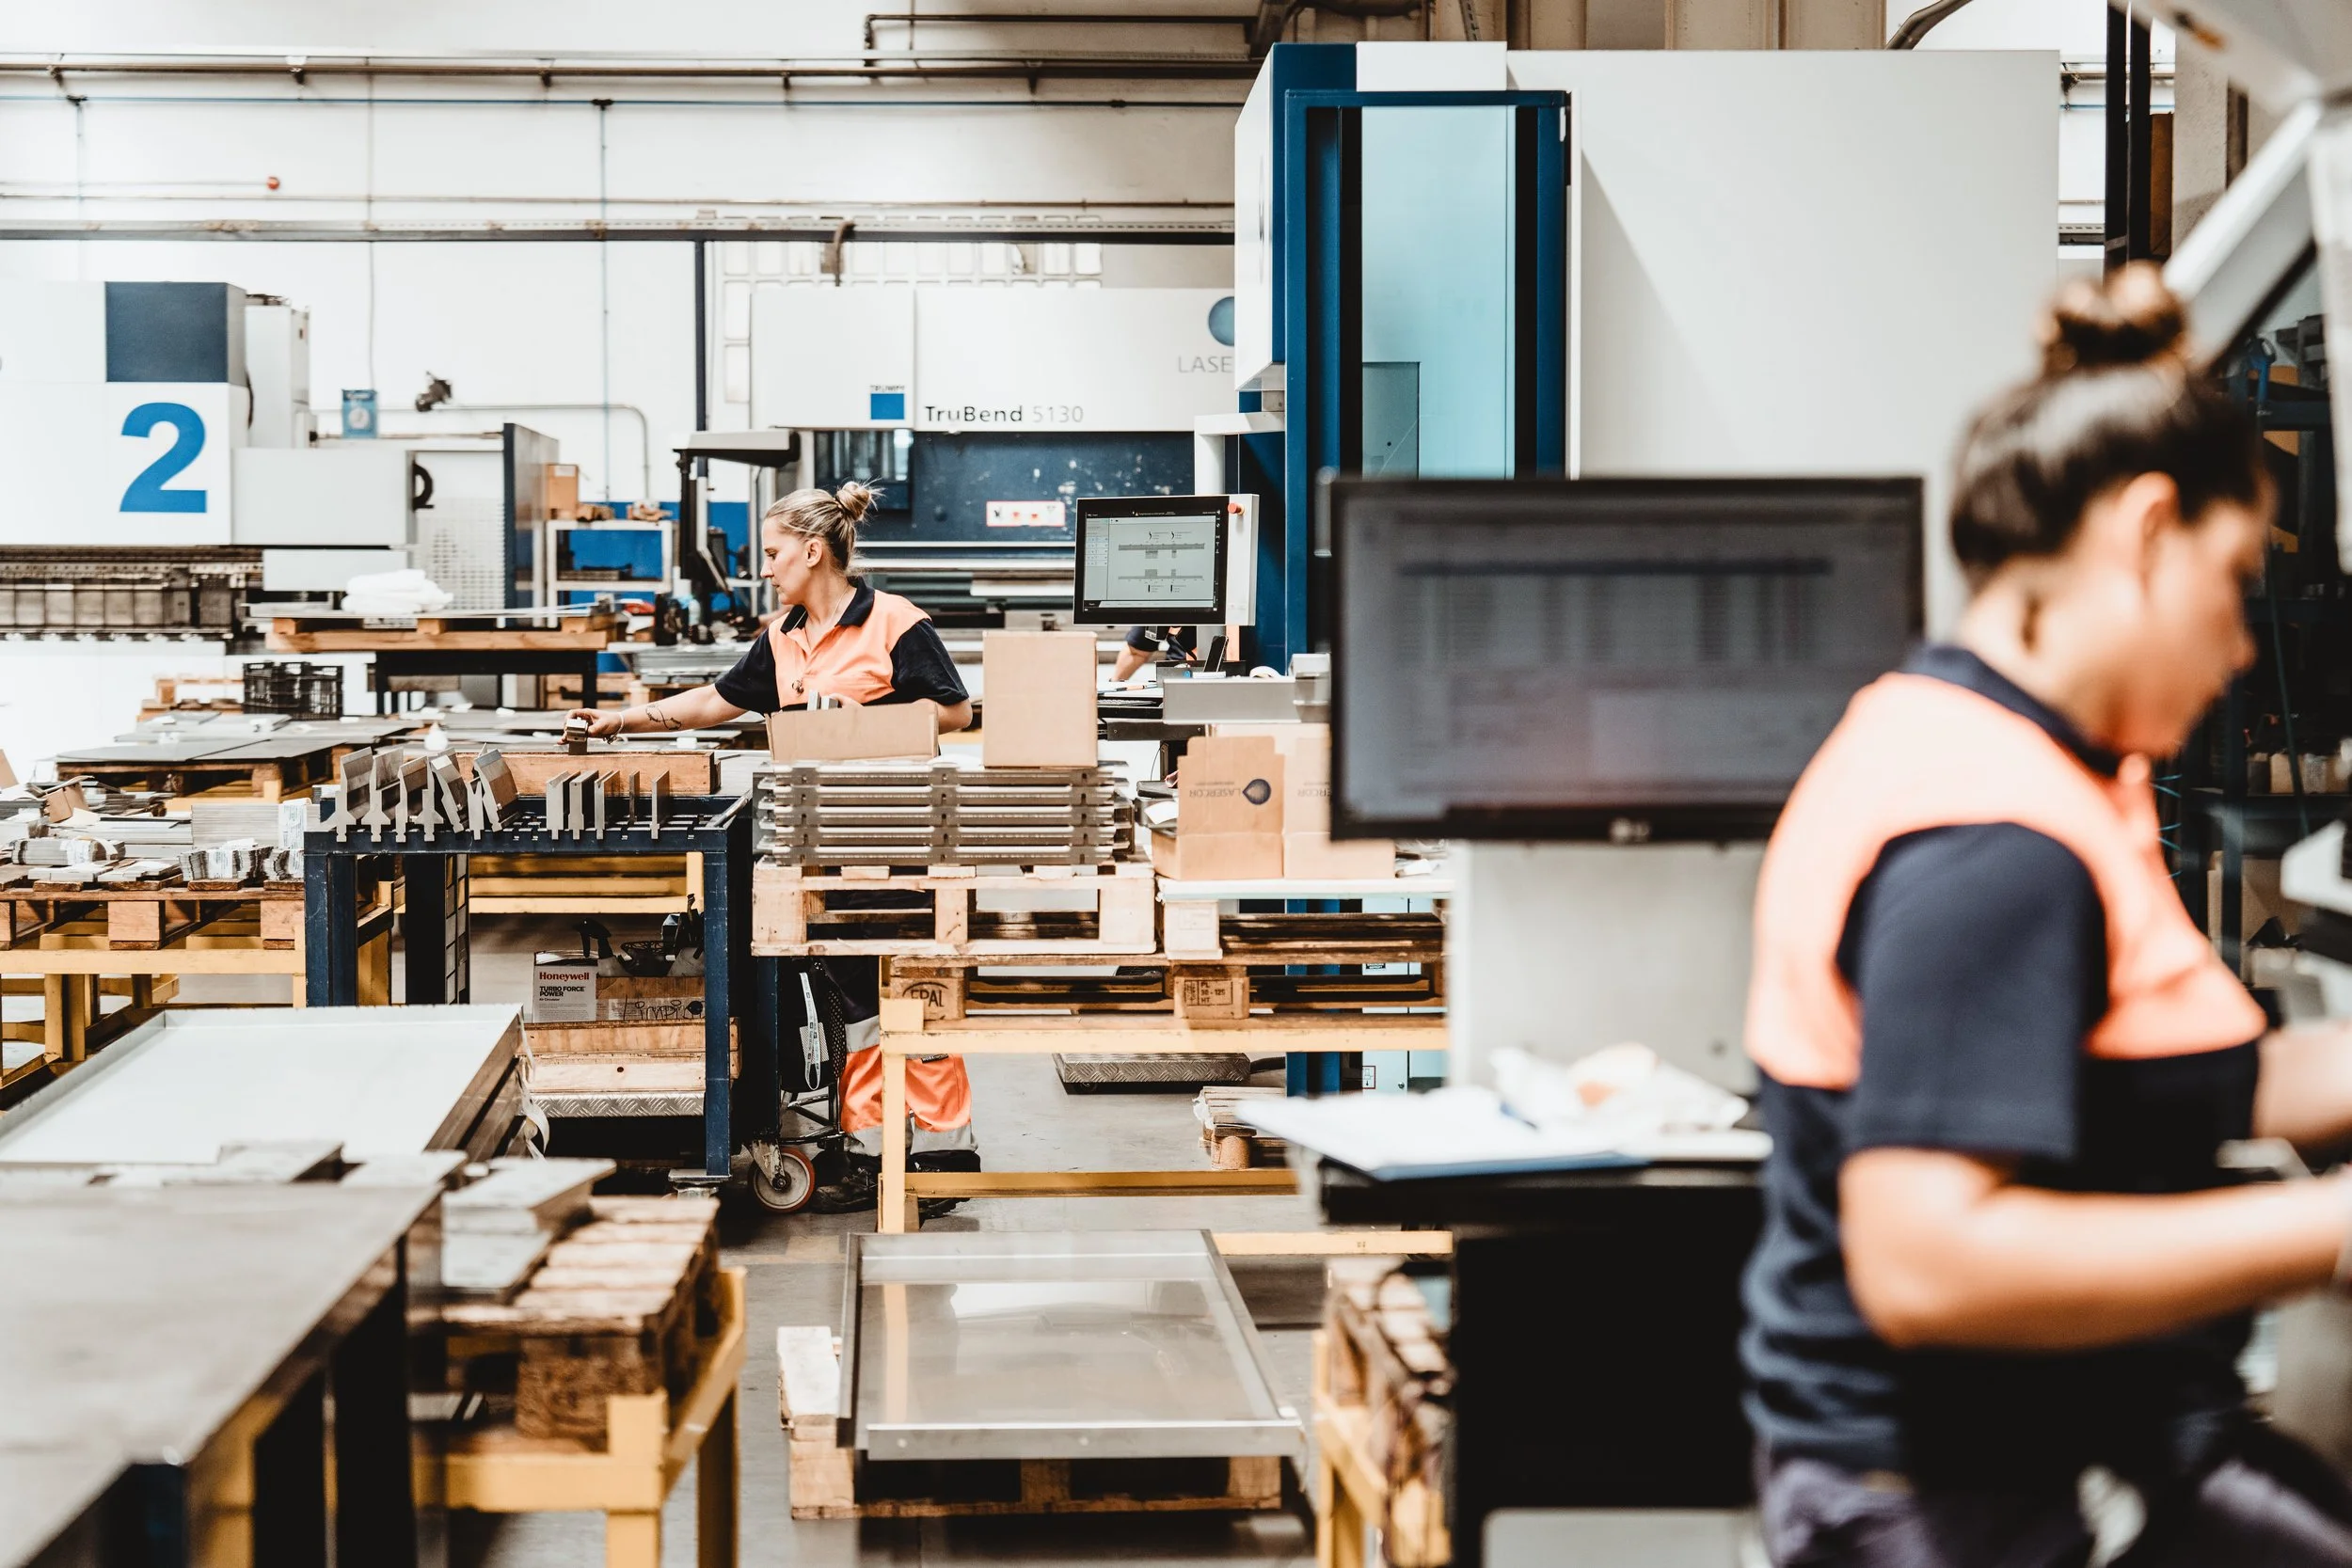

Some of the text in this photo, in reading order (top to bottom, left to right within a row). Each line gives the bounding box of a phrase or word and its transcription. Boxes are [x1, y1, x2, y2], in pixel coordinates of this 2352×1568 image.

[1178, 356, 1234, 373] LASE
[925, 405, 1084, 423] TruBend 5130
[119, 402, 207, 514] 2
[1189, 788, 1241, 798] LASERCOR
[539, 972, 590, 982] Honeywell
